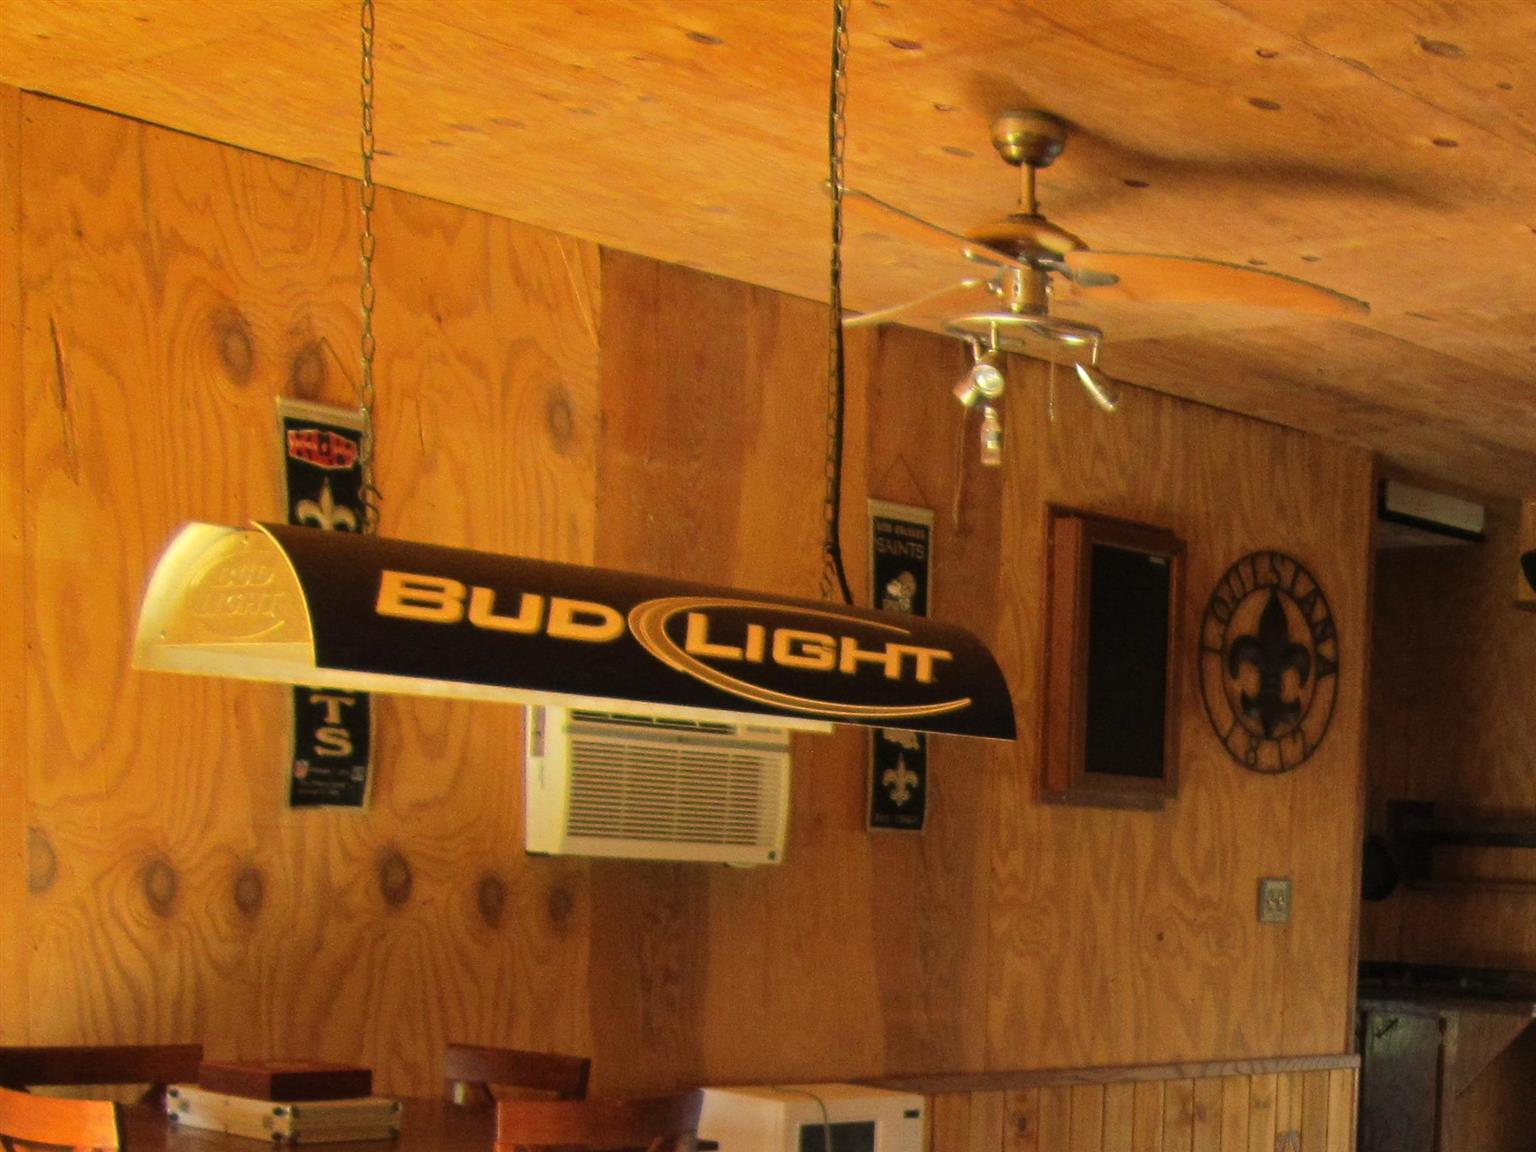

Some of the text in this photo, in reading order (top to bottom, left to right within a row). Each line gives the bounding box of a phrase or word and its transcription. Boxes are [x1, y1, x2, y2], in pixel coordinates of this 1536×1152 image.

[877, 536, 926, 560] SAINTS
[375, 570, 953, 683] BUD LIGHT
[1200, 548, 1339, 682] LOUISIANA
